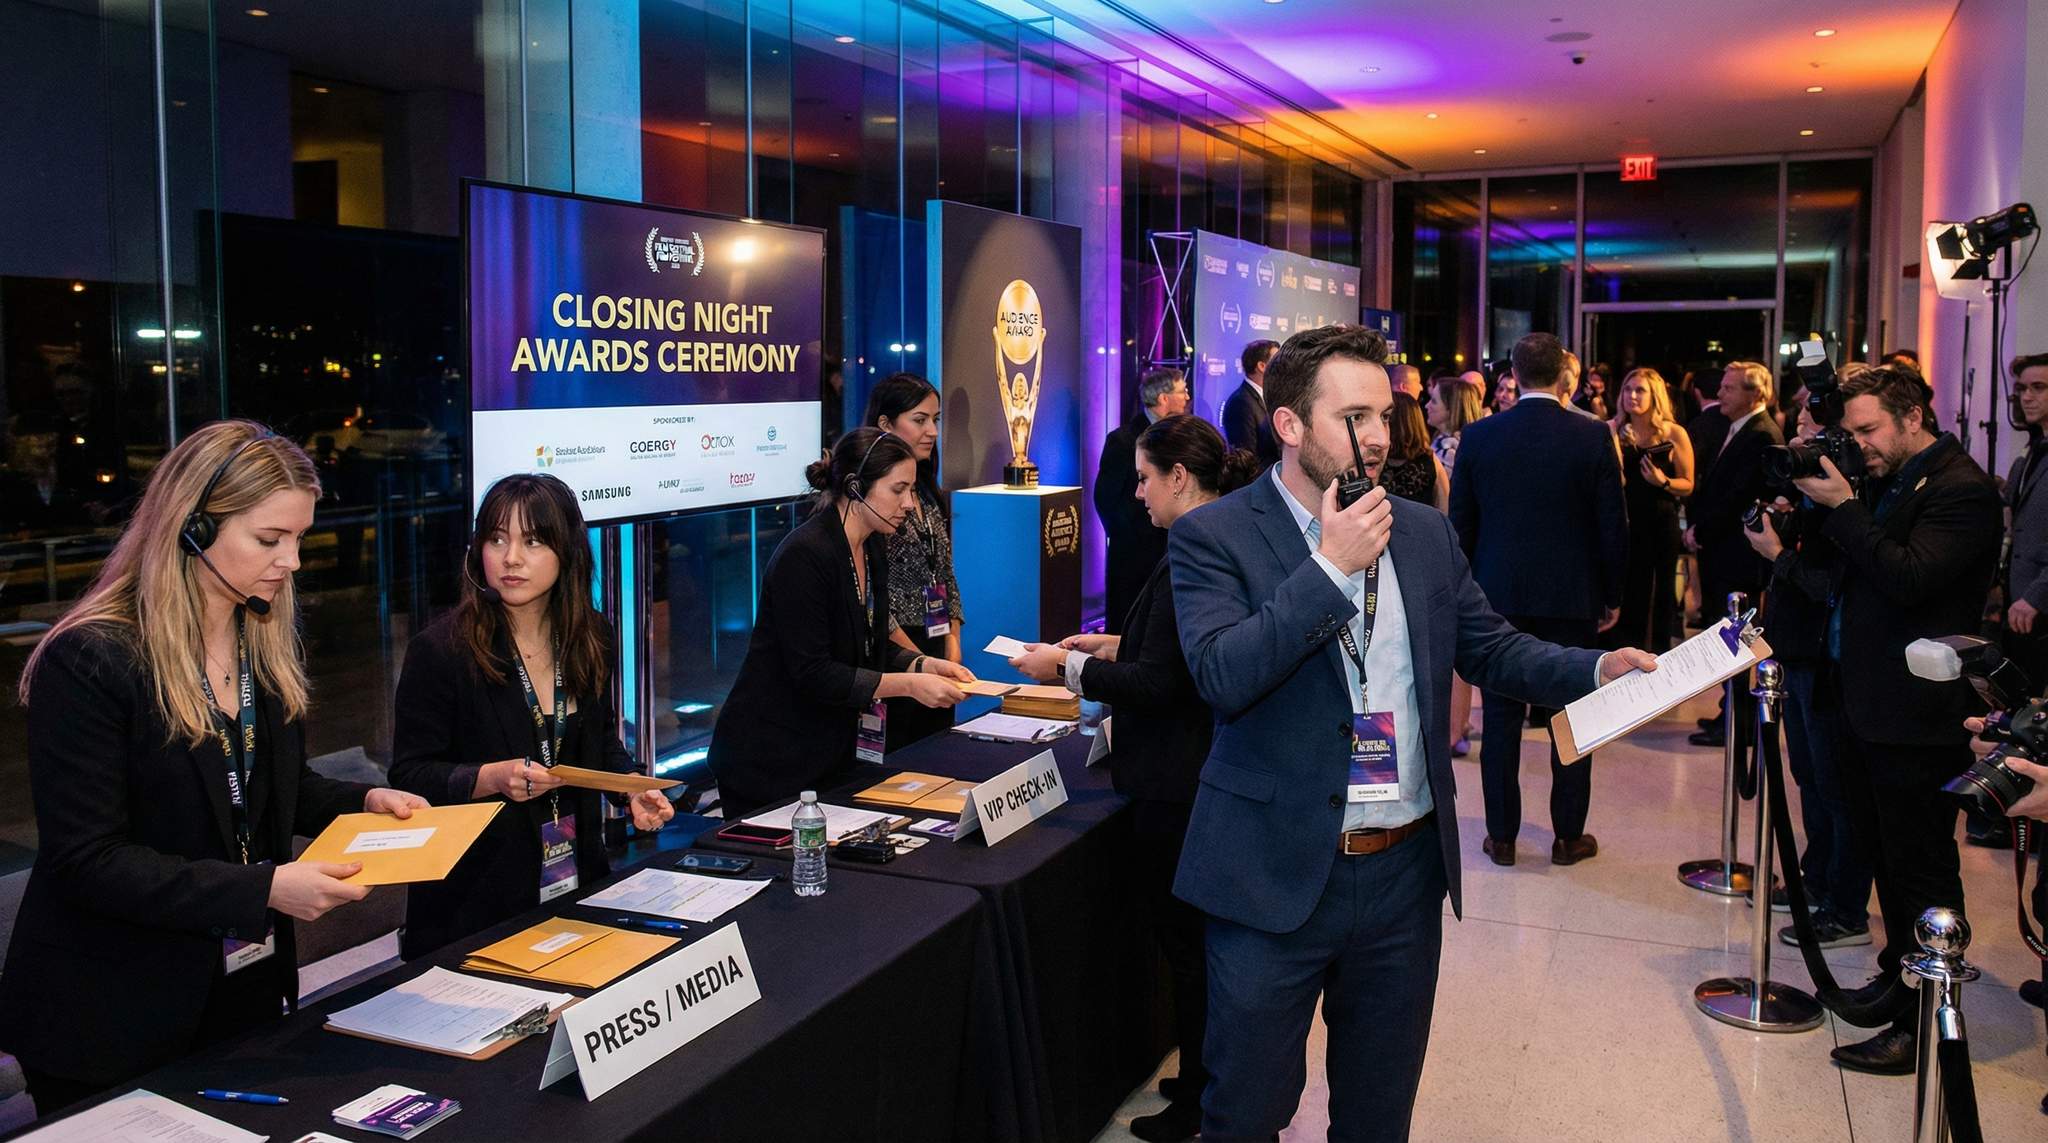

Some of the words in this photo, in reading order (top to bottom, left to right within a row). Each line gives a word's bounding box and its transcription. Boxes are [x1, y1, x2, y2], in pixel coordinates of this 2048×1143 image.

[1625, 158, 1654, 179] EXIT
[552, 292, 686, 332] CLOSING
[694, 301, 773, 335] NIGHT
[510, 338, 649, 373] AWARDS
[657, 340, 801, 373] CEREMONY
[629, 440, 676, 454] COERGY
[581, 486, 631, 502] SAMSUNG
[983, 797, 1004, 822] VIP
[1006, 768, 1058, 811] CHECK-IN
[583, 999, 661, 1063] PRESS
[665, 989, 672, 1022] /
[675, 955, 744, 1011] MEDIA
